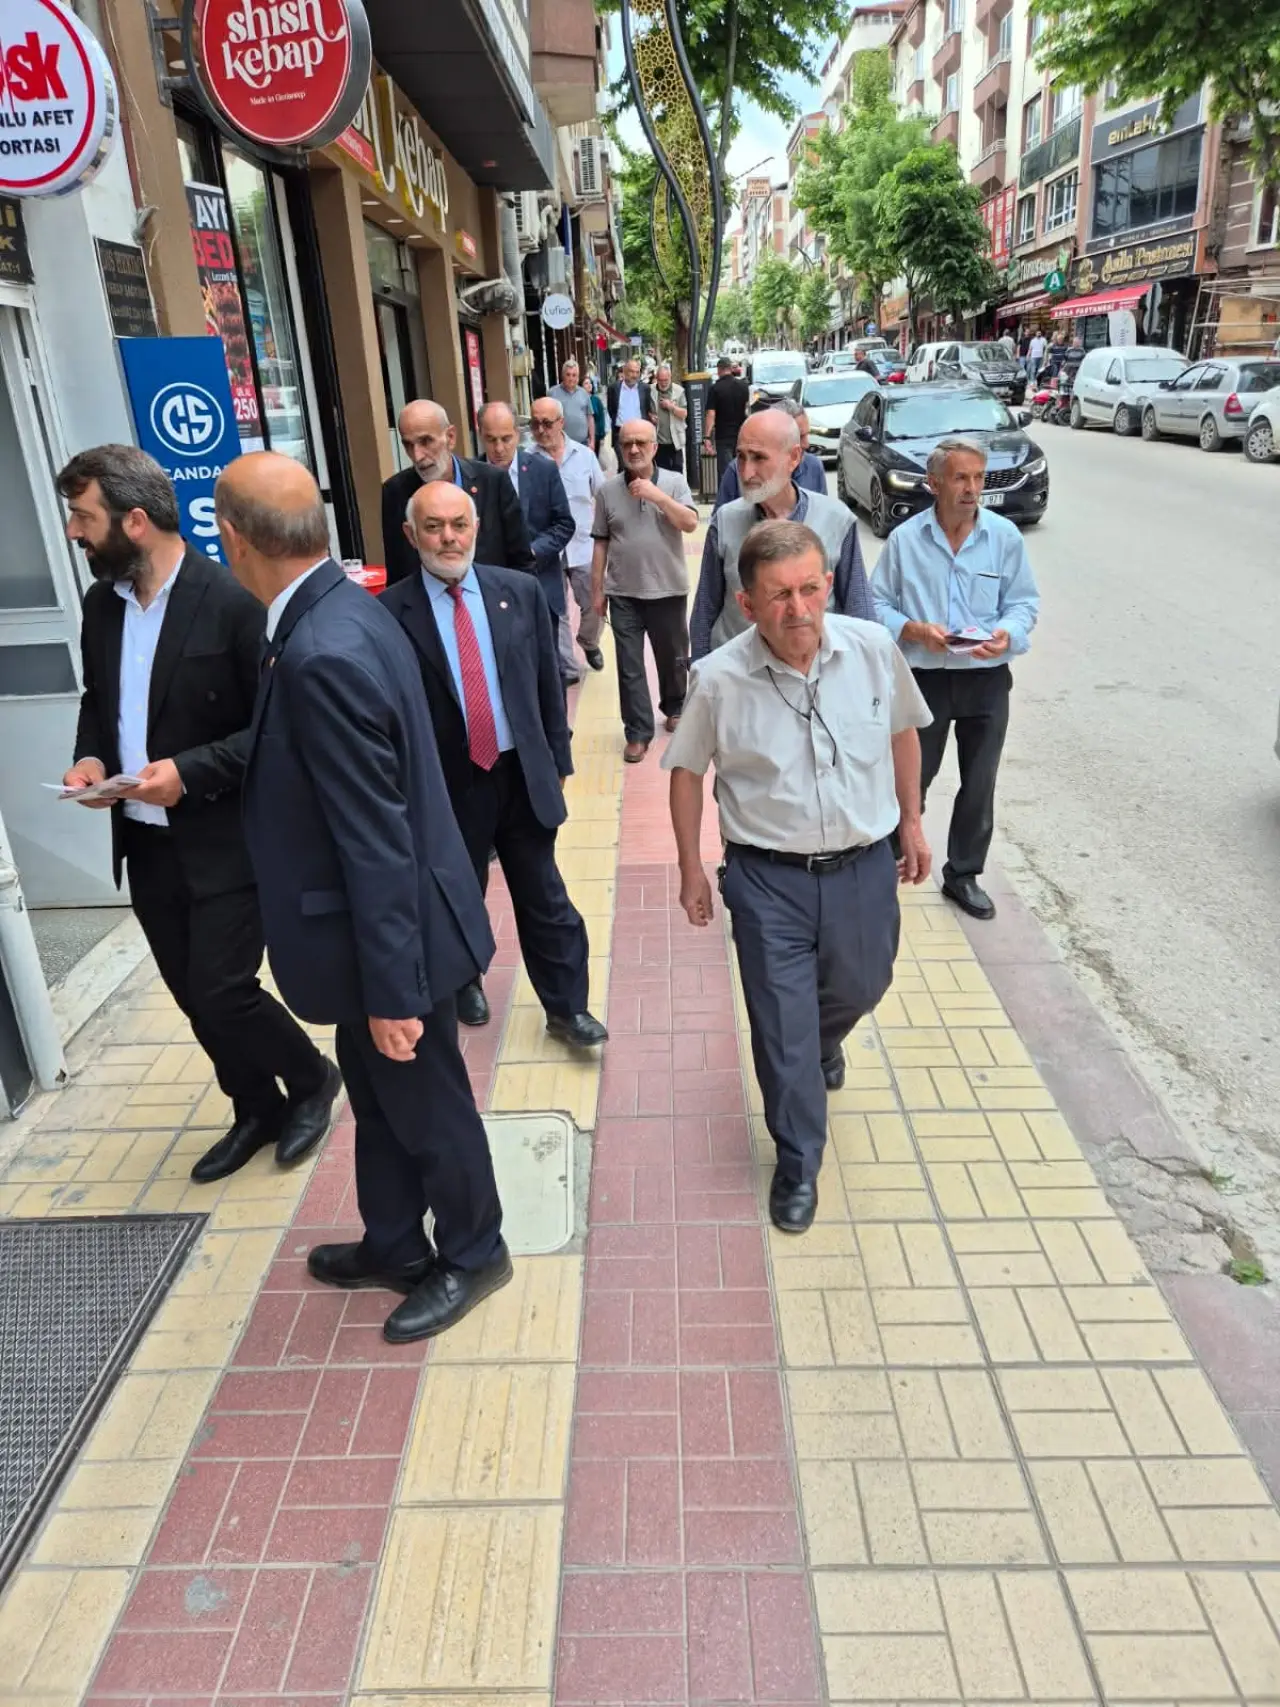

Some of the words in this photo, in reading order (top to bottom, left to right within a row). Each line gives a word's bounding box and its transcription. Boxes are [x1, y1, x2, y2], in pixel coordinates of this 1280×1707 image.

[226, 0, 347, 43] shish
[221, 37, 324, 89] kebap
[33, 109, 74, 127] AFET
[0, 138, 60, 156] ORTASI
[233, 397, 259, 421] 250
